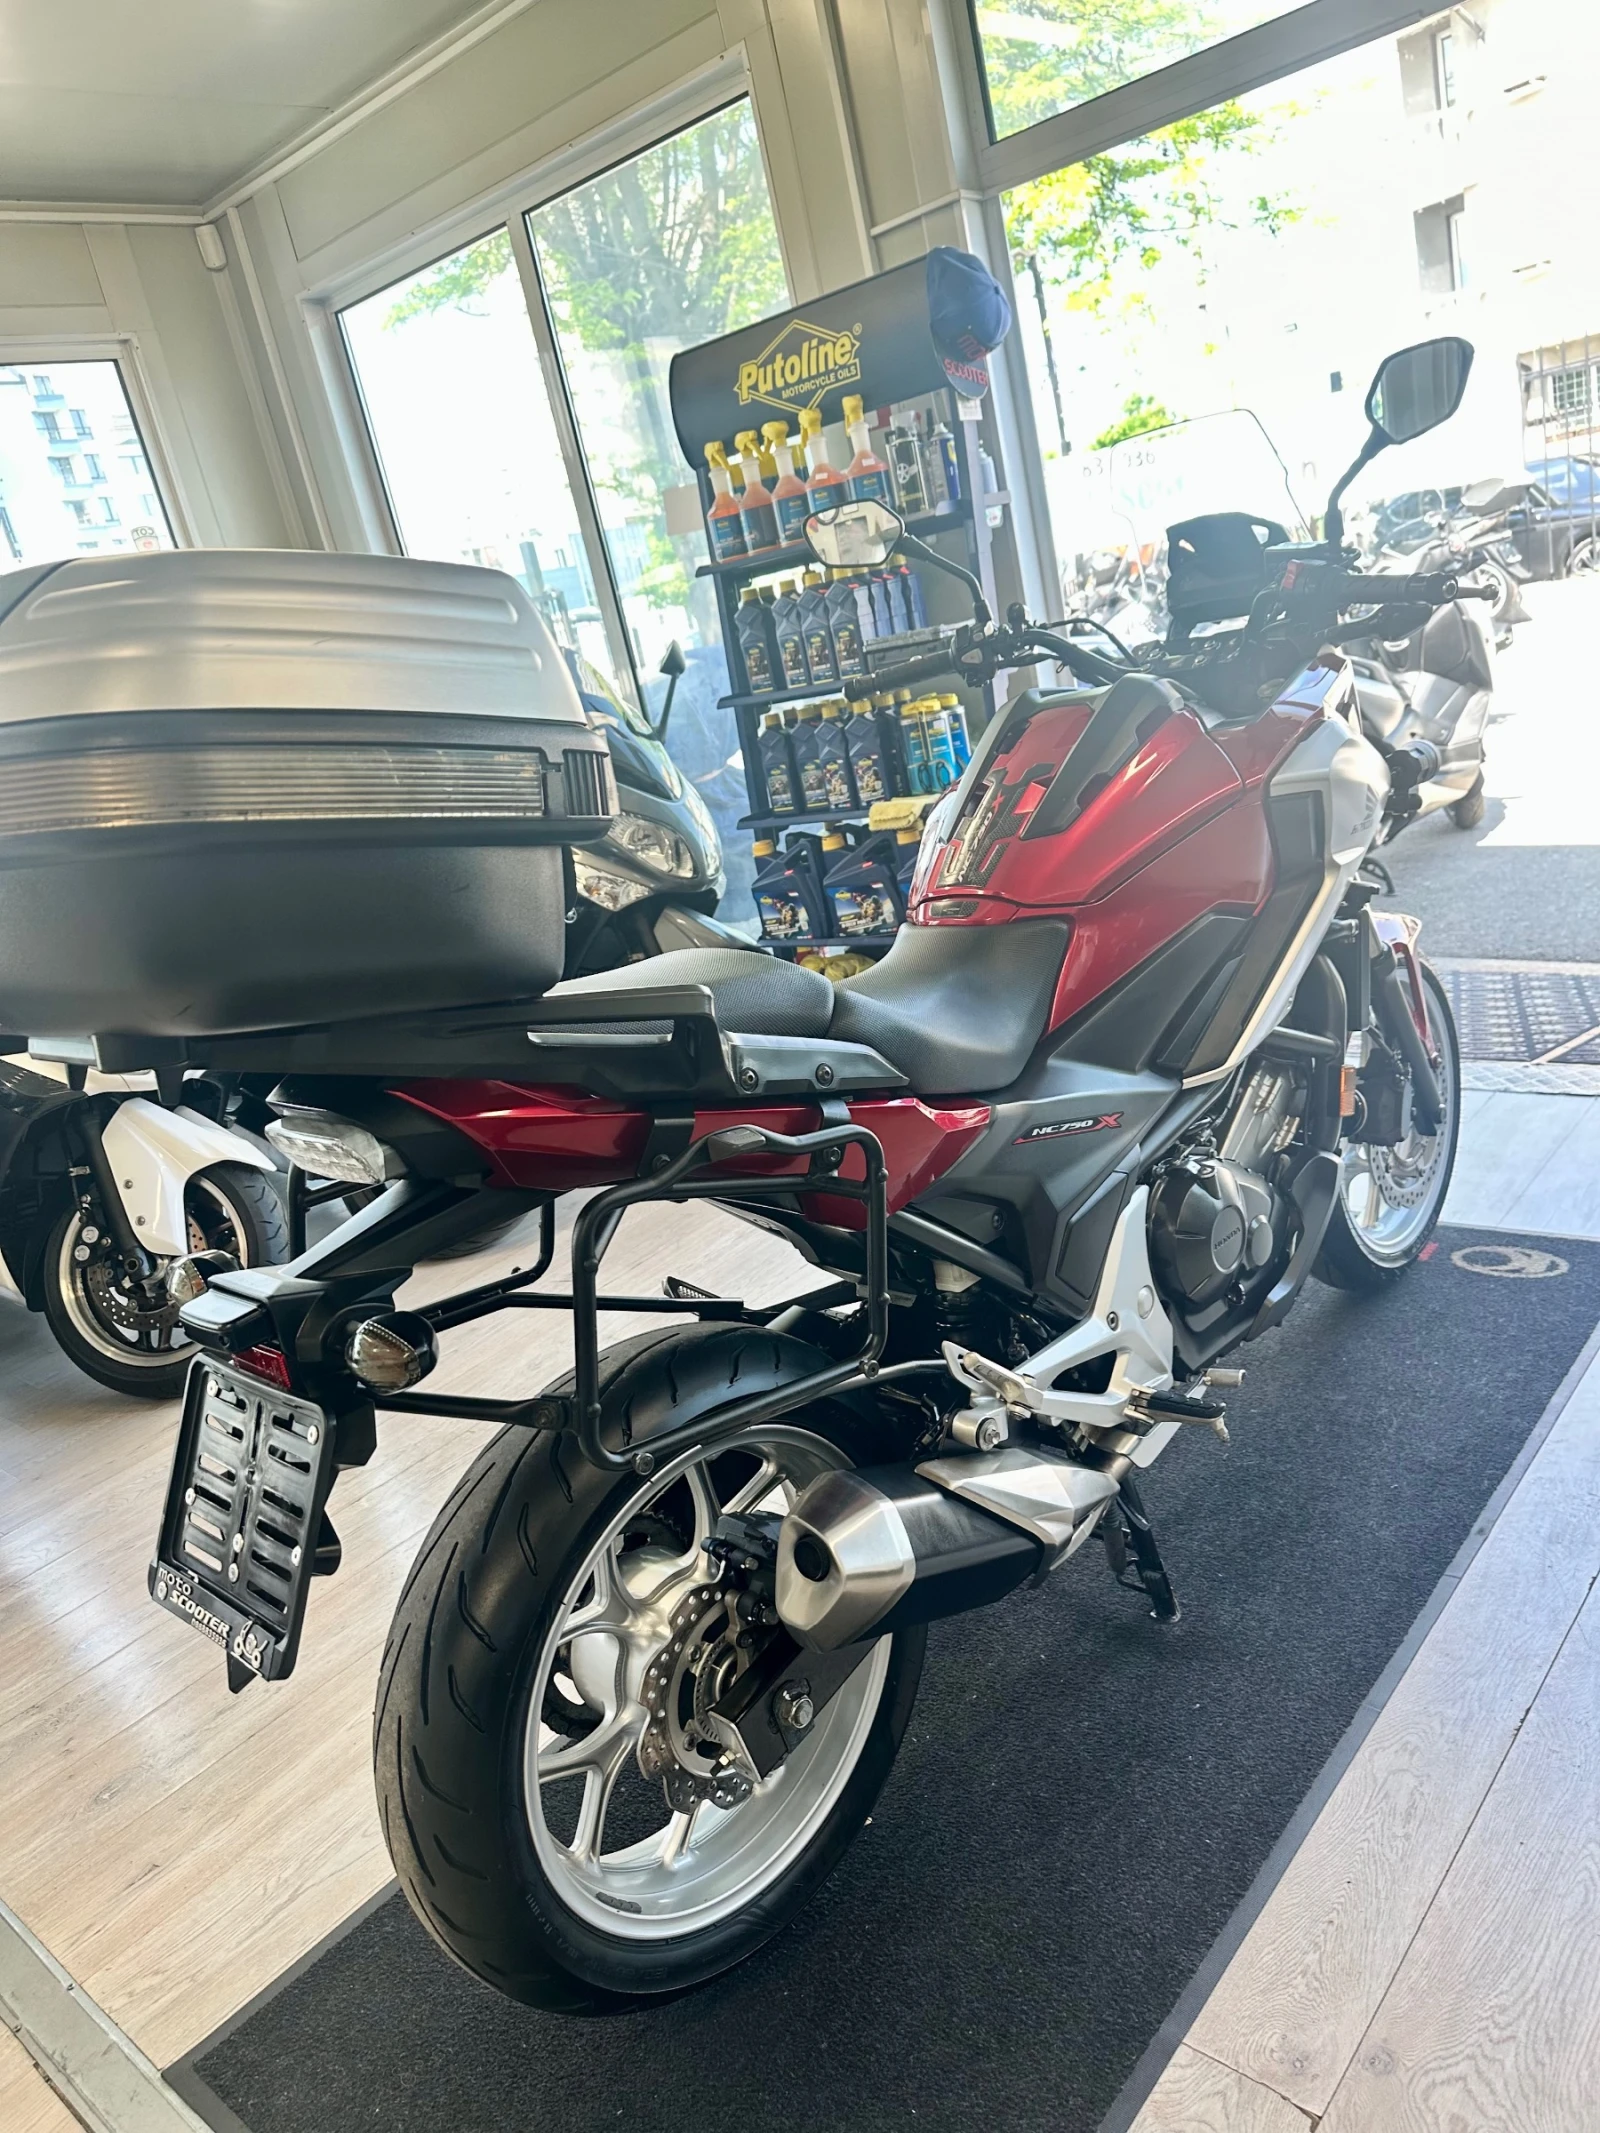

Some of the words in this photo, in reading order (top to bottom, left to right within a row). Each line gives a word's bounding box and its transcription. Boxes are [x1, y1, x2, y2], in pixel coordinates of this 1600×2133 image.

[740, 335, 853, 400] Putoline
[781, 373, 836, 399] MOTORCYCLE
[836, 365, 858, 380] OILS
[1214, 1226, 1241, 1250] HONDA
[158, 1567, 192, 1596] moto
[169, 1590, 230, 1639] SCOOTER
